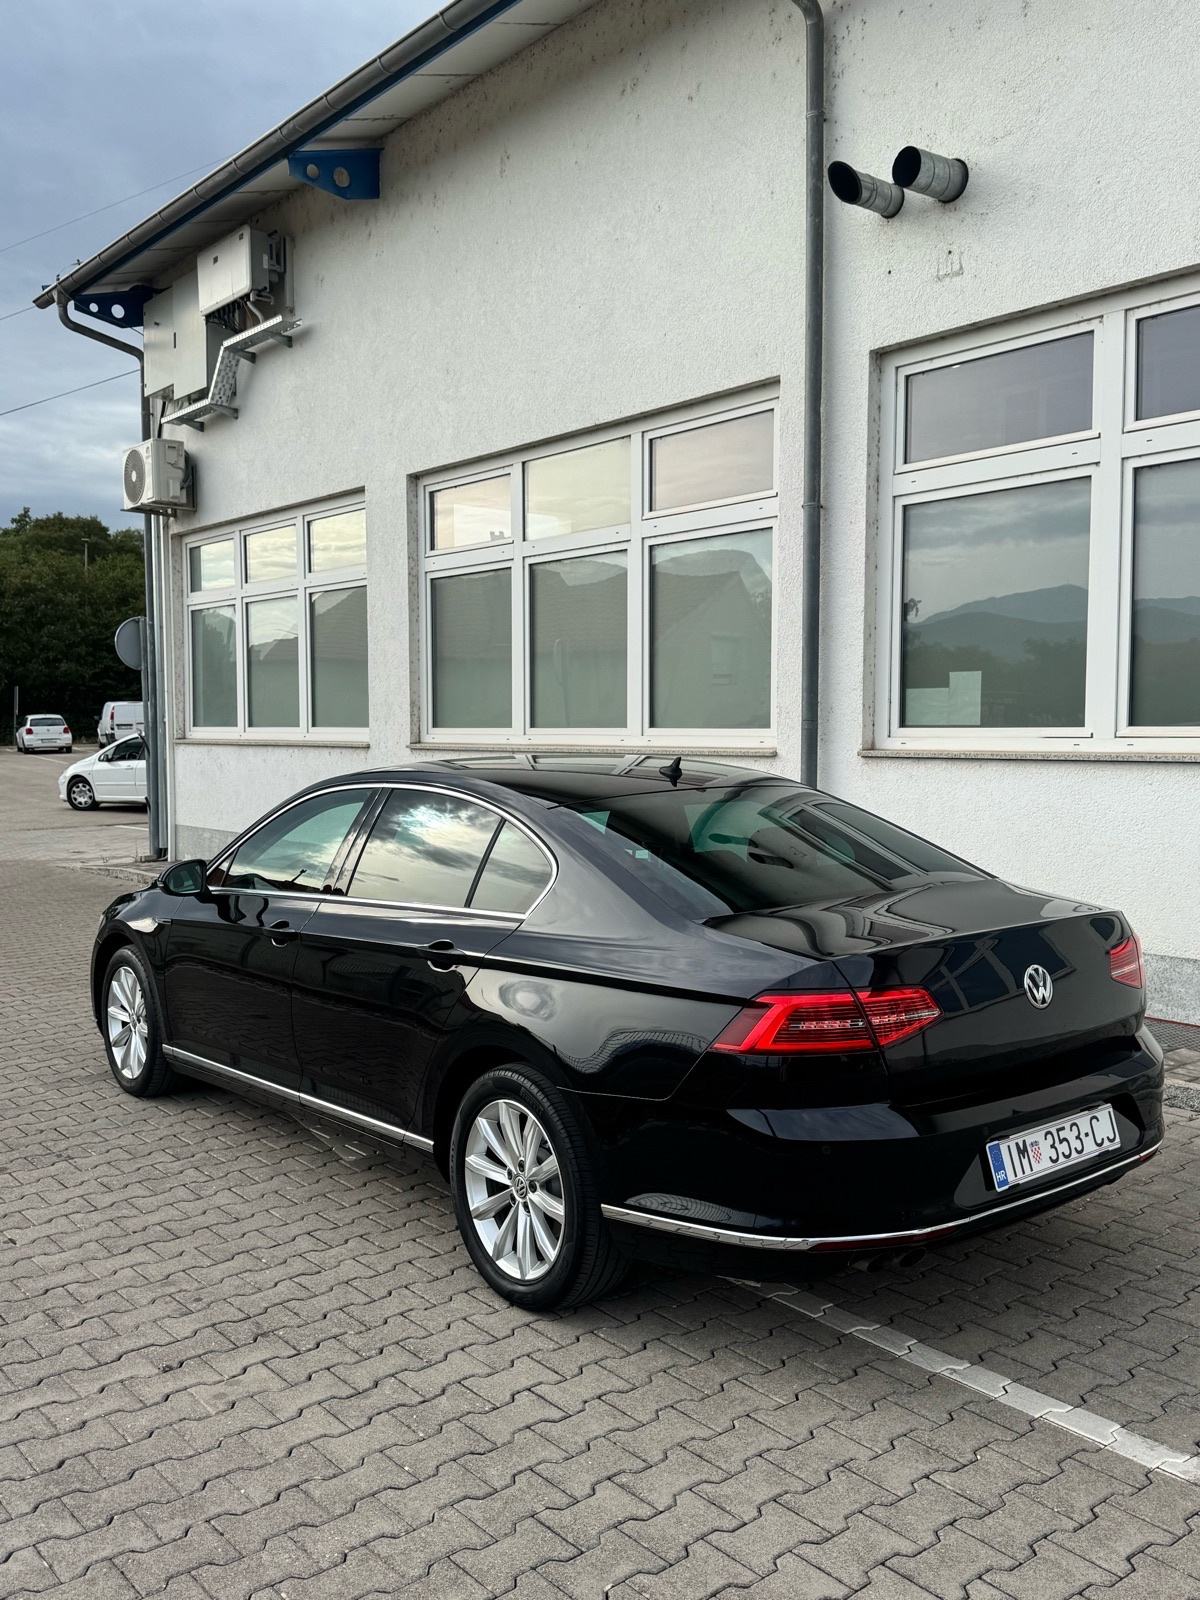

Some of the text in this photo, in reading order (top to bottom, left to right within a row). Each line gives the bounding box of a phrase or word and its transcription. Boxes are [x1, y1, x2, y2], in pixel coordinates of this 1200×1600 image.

[1007, 1111, 1117, 1178] IM 353-CJ
[995, 1170, 1007, 1182] HR
